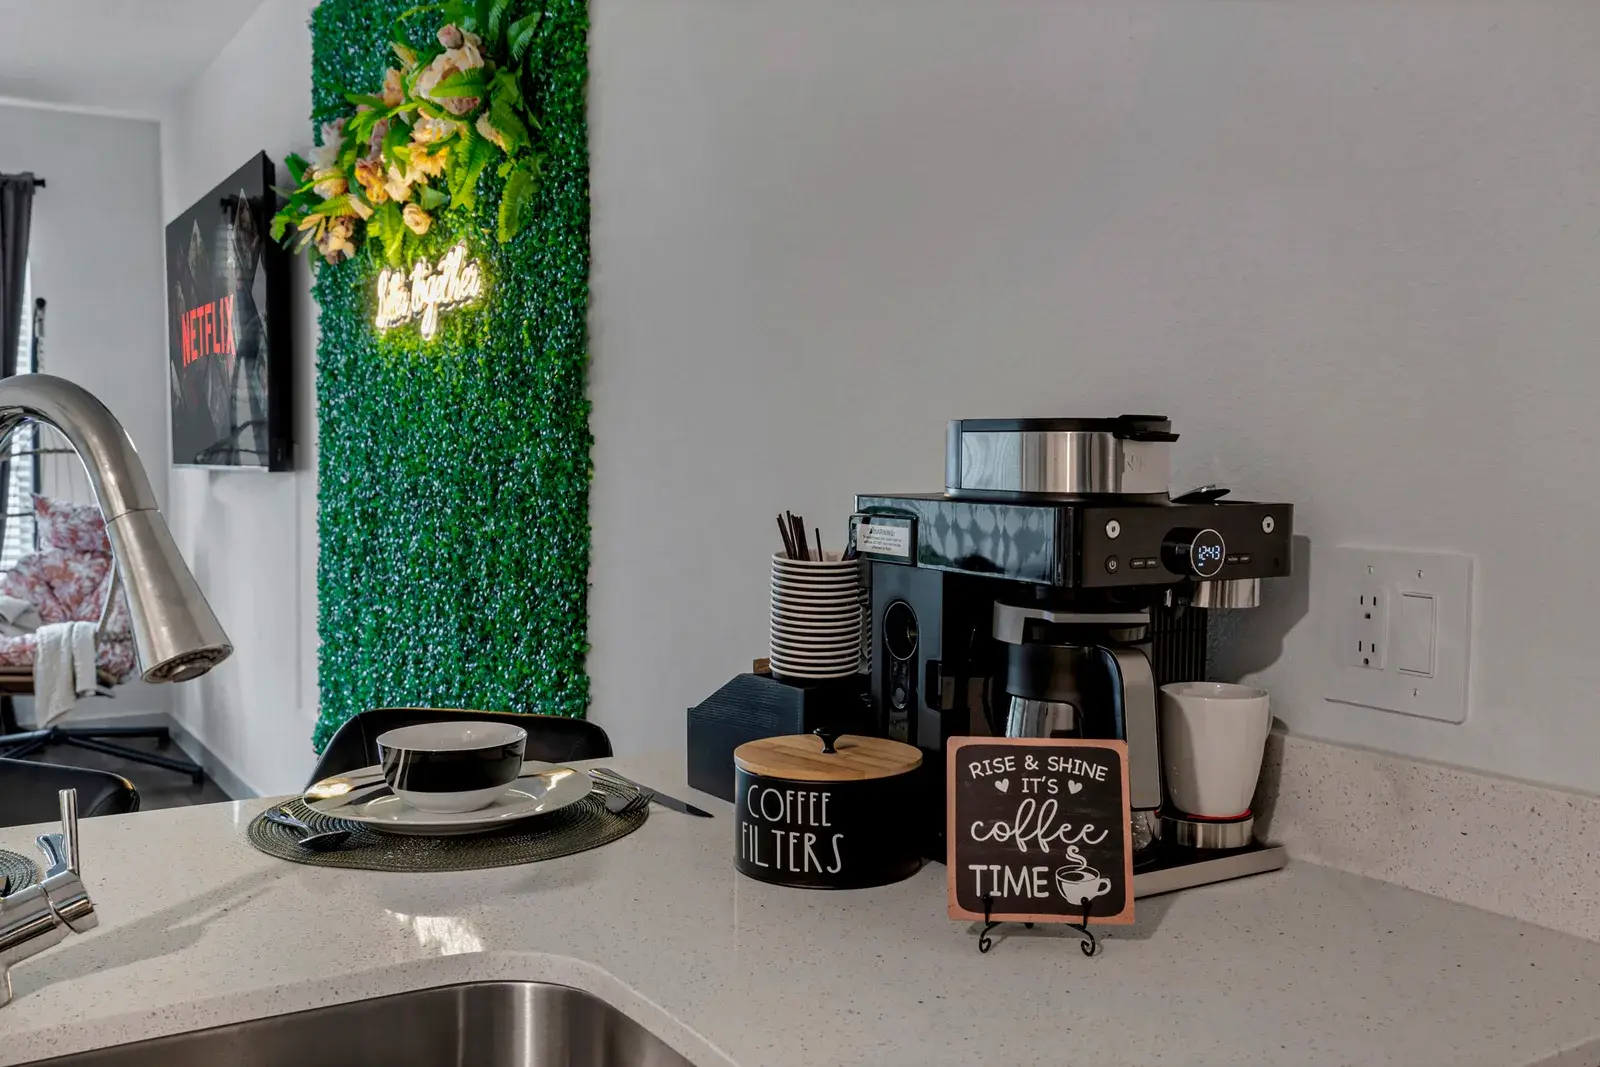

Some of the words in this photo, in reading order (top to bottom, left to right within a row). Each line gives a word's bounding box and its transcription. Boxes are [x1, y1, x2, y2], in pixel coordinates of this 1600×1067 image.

[182, 294, 236, 368] NETFLIX
[968, 755, 1016, 779] RISE
[1024, 754, 1039, 771] &
[1047, 755, 1109, 782] SHINE
[1021, 775, 1059, 794] IT'S
[747, 784, 832, 827] COFFEE
[970, 798, 1109, 853] coffee
[742, 821, 844, 874] FILTERS
[968, 864, 1050, 898] TIME
